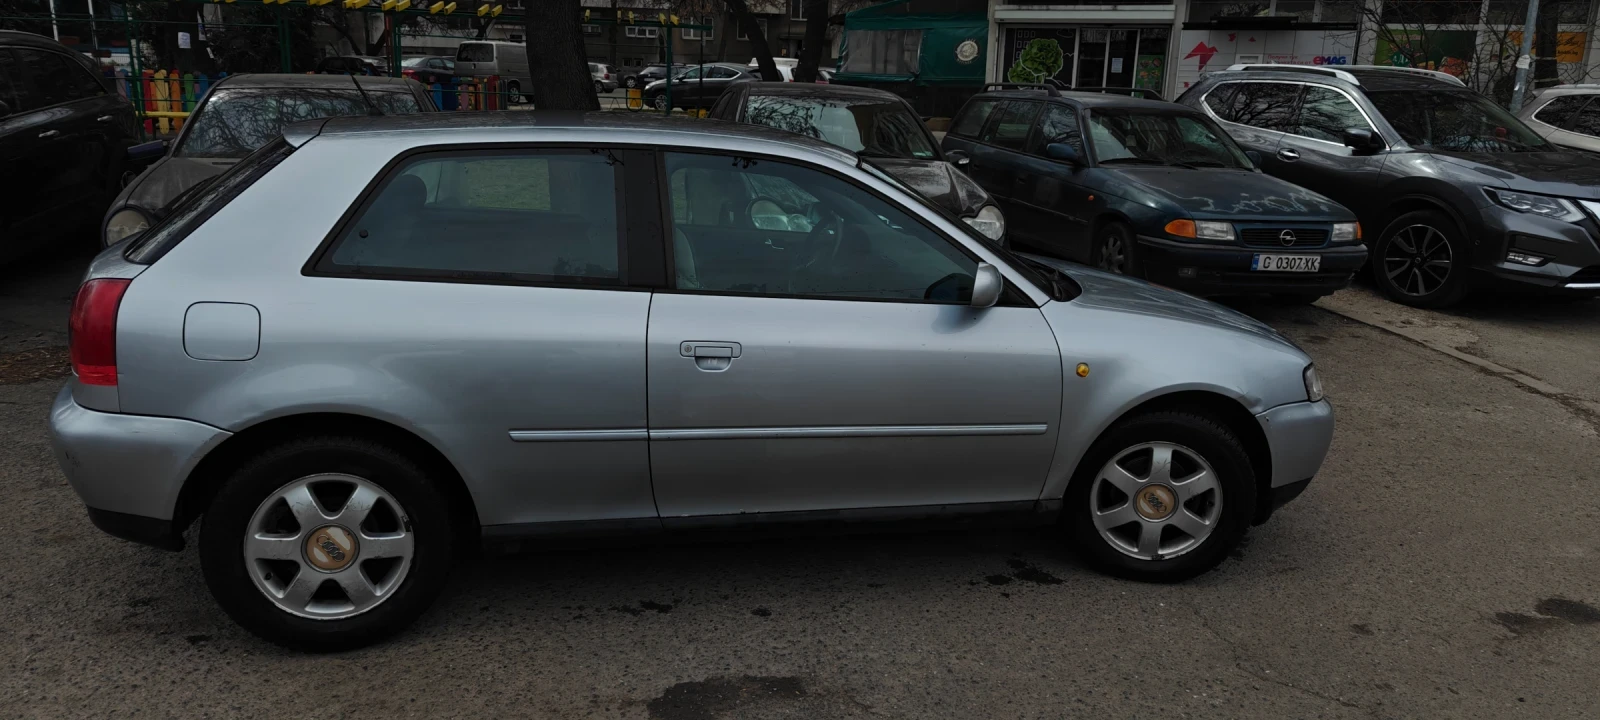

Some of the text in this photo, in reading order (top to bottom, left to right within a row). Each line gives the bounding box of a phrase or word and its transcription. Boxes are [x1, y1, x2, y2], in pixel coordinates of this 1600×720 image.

[1313, 56, 1346, 65] eMAG
[1276, 256, 1303, 270] 0307
[1303, 257, 1318, 271] XK
